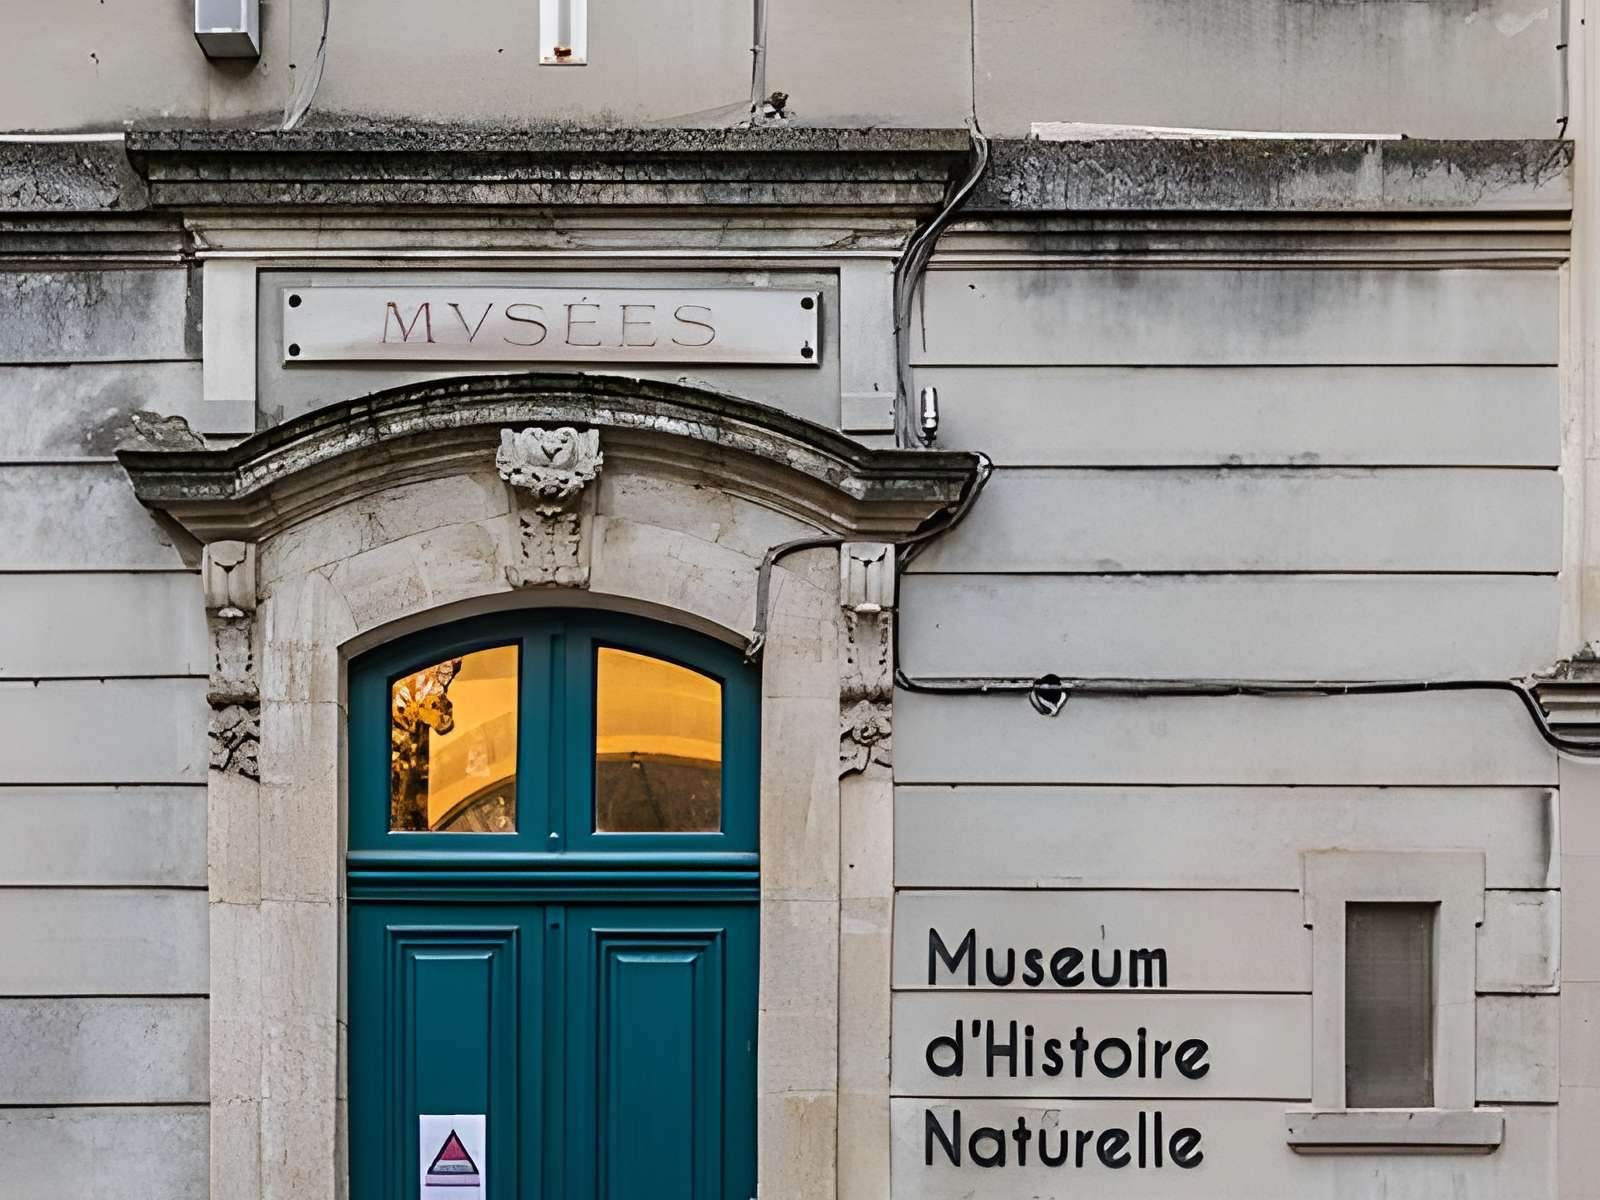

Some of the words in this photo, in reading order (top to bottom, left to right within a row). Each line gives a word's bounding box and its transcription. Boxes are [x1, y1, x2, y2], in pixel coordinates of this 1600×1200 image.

[928, 928, 1167, 987] Museum
[926, 1019, 1210, 1080] d'Histoire
[925, 1109, 1204, 1169] Naturelle
